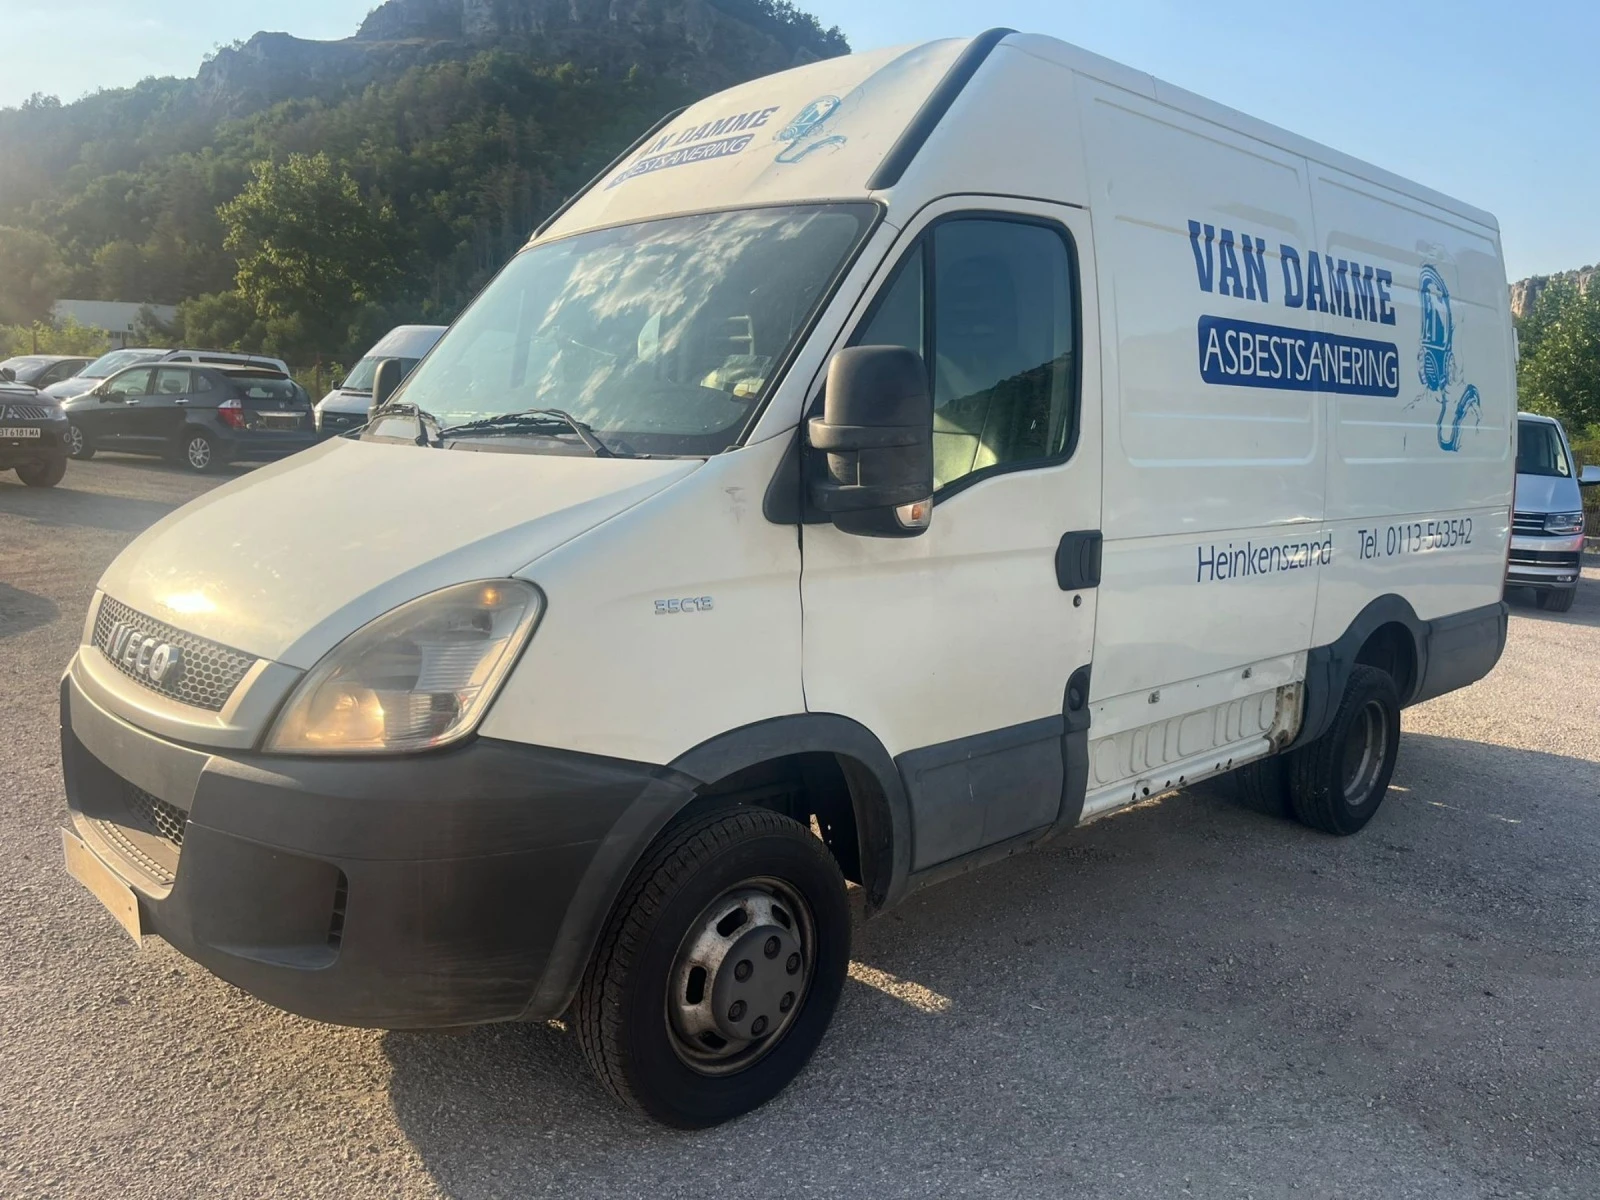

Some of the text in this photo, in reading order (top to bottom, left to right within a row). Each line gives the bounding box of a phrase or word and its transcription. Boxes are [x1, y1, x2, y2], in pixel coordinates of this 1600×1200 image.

[669, 106, 781, 147] DAMME
[1188, 219, 1397, 326] VAN DAMME
[1203, 327, 1398, 389] ASBESTSANERING
[1197, 517, 1473, 582] Heinkenszand Tel. 0113-563542
[106, 621, 178, 682] IVECO
